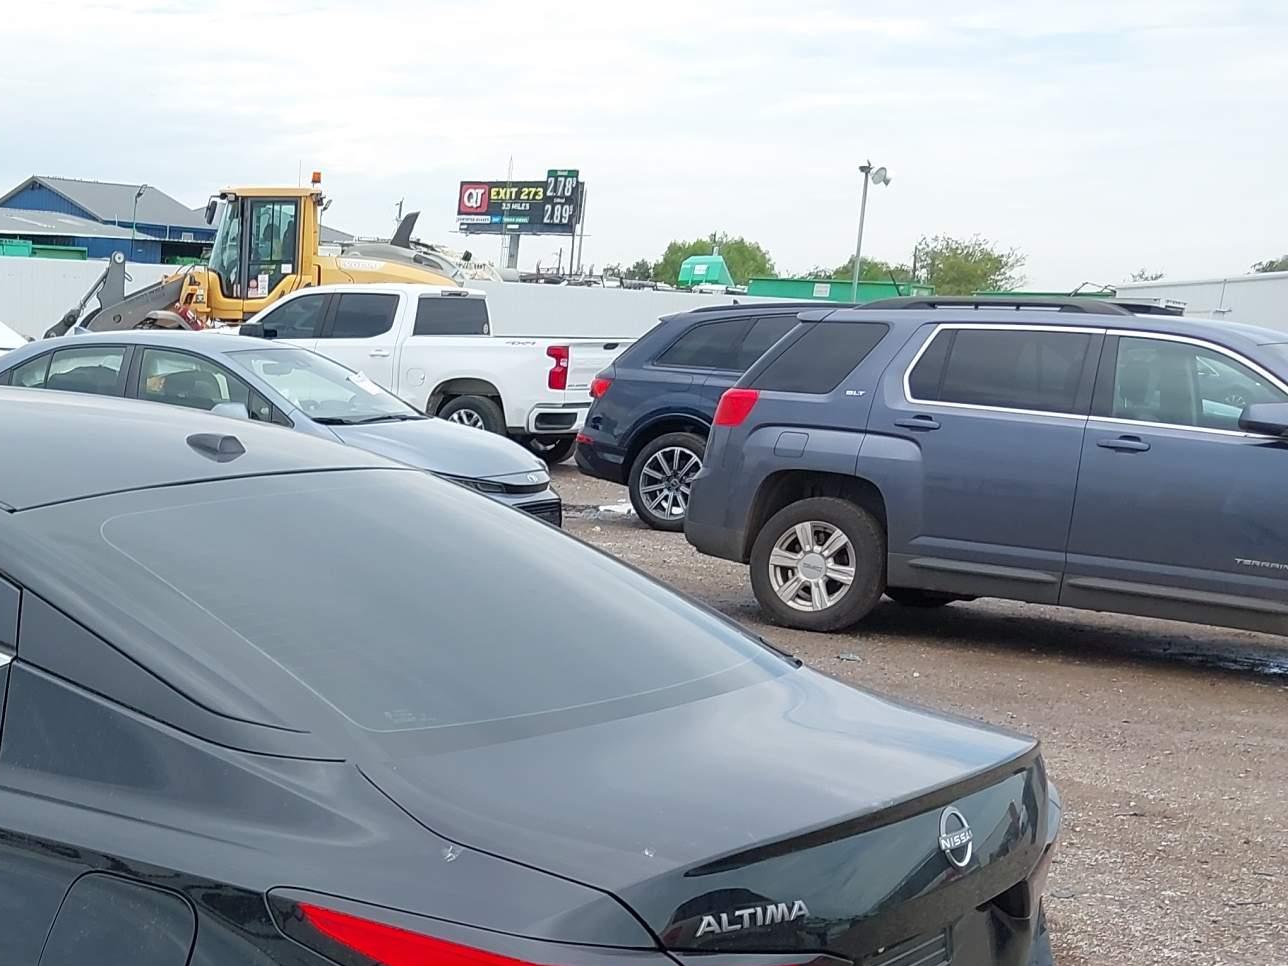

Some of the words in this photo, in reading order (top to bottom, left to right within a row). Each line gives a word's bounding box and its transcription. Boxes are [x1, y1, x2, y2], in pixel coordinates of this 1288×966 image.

[463, 188, 485, 208] QT
[490, 187, 518, 200] EXIT
[519, 187, 544, 200] 273
[512, 202, 530, 210] MILES
[695, 899, 810, 938] ALTIMA
